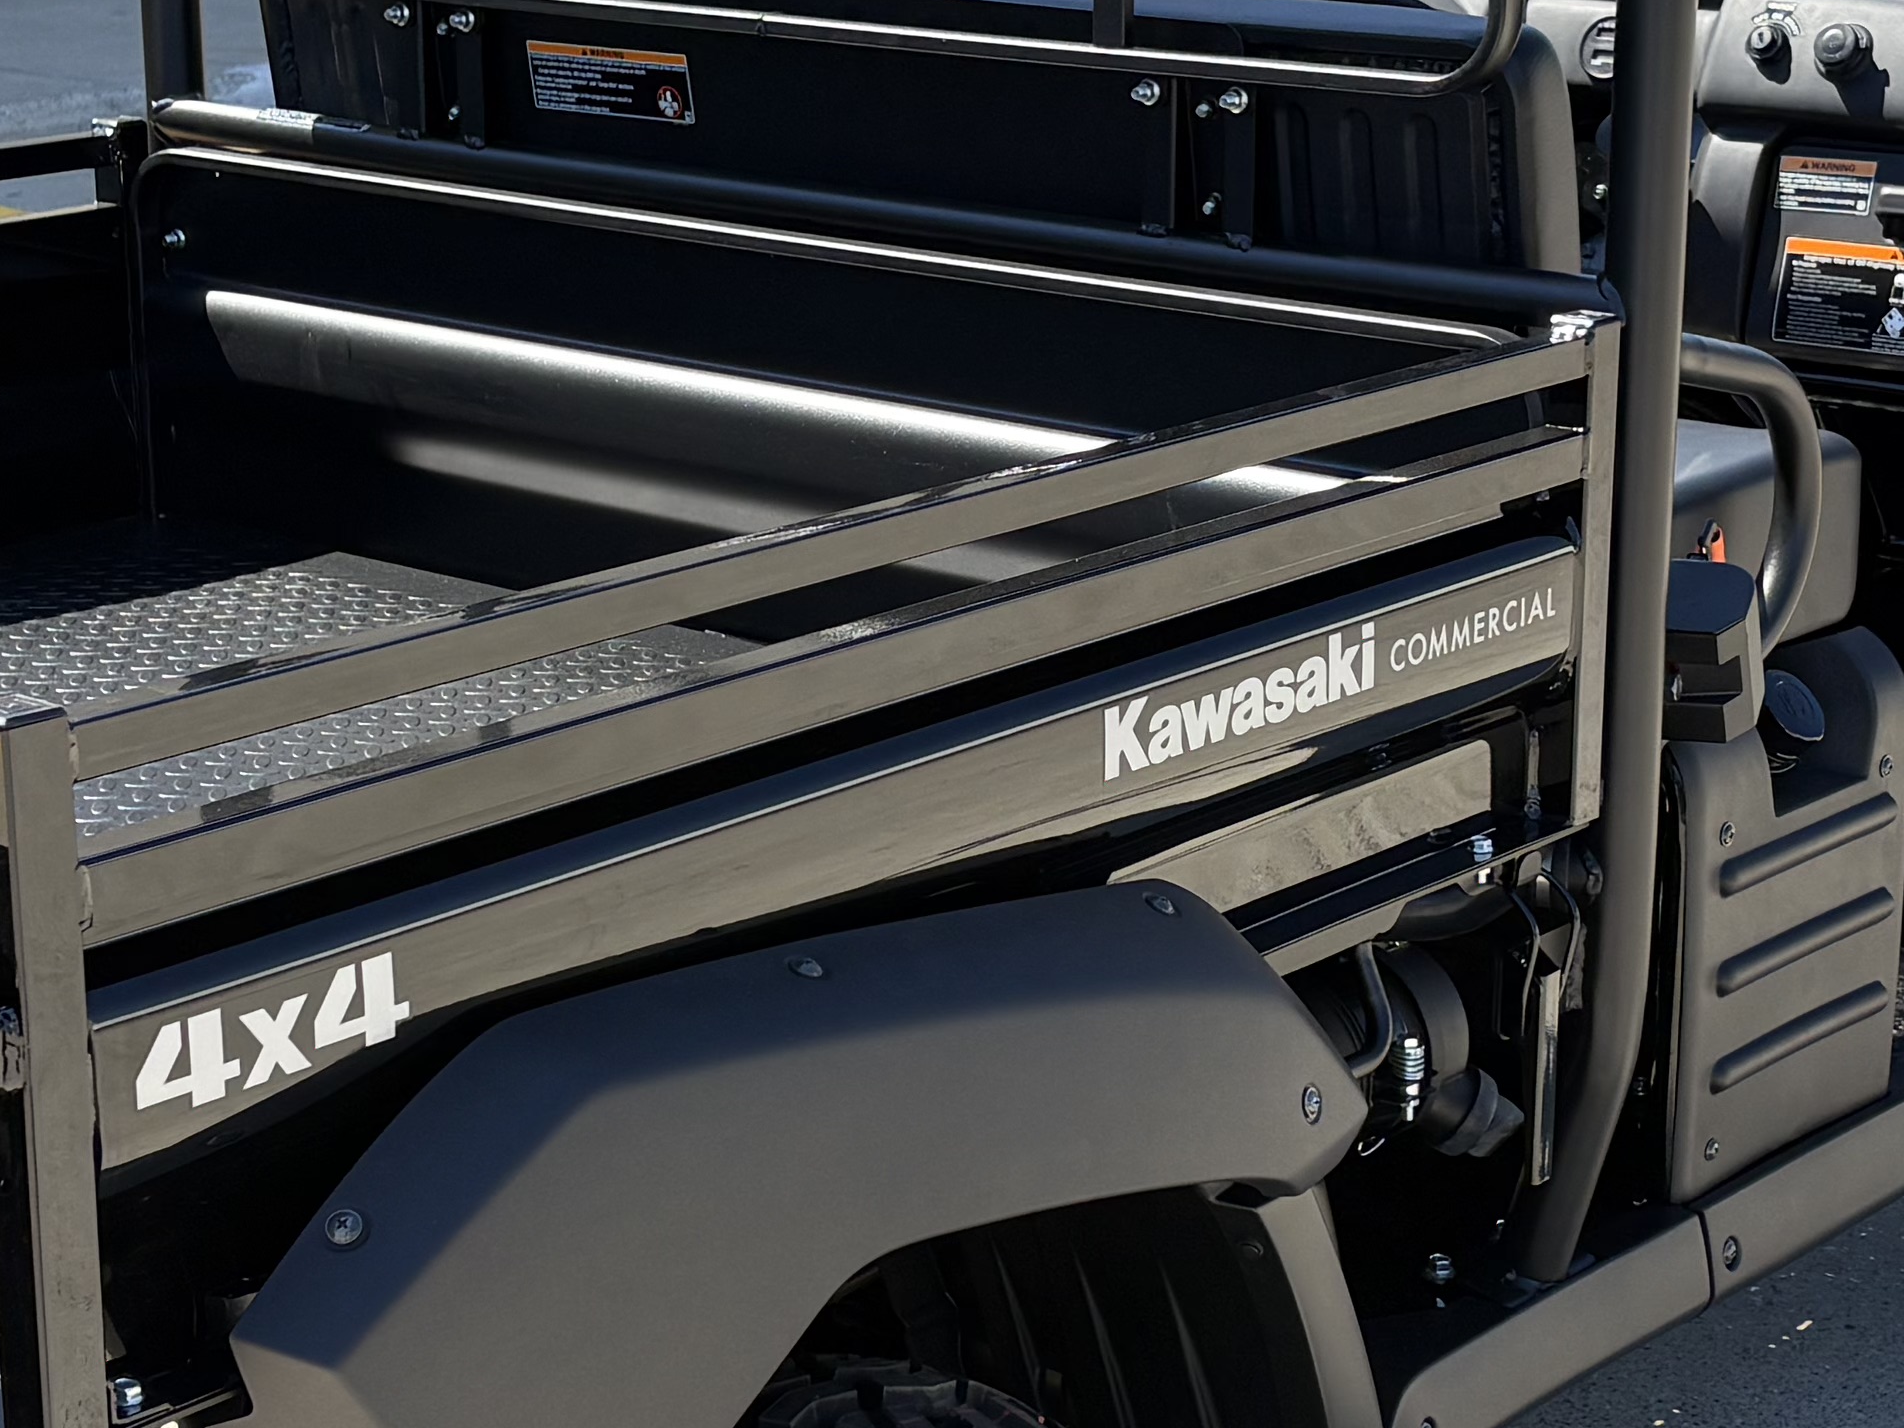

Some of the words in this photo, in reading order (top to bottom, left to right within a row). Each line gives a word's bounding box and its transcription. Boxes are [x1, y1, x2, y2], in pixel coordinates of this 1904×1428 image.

[1811, 161, 1856, 172] WARNING
[1104, 621, 1375, 781] Kawasaki
[1390, 587, 1556, 671] COMMERCIAL
[135, 951, 411, 1110] 4x4
